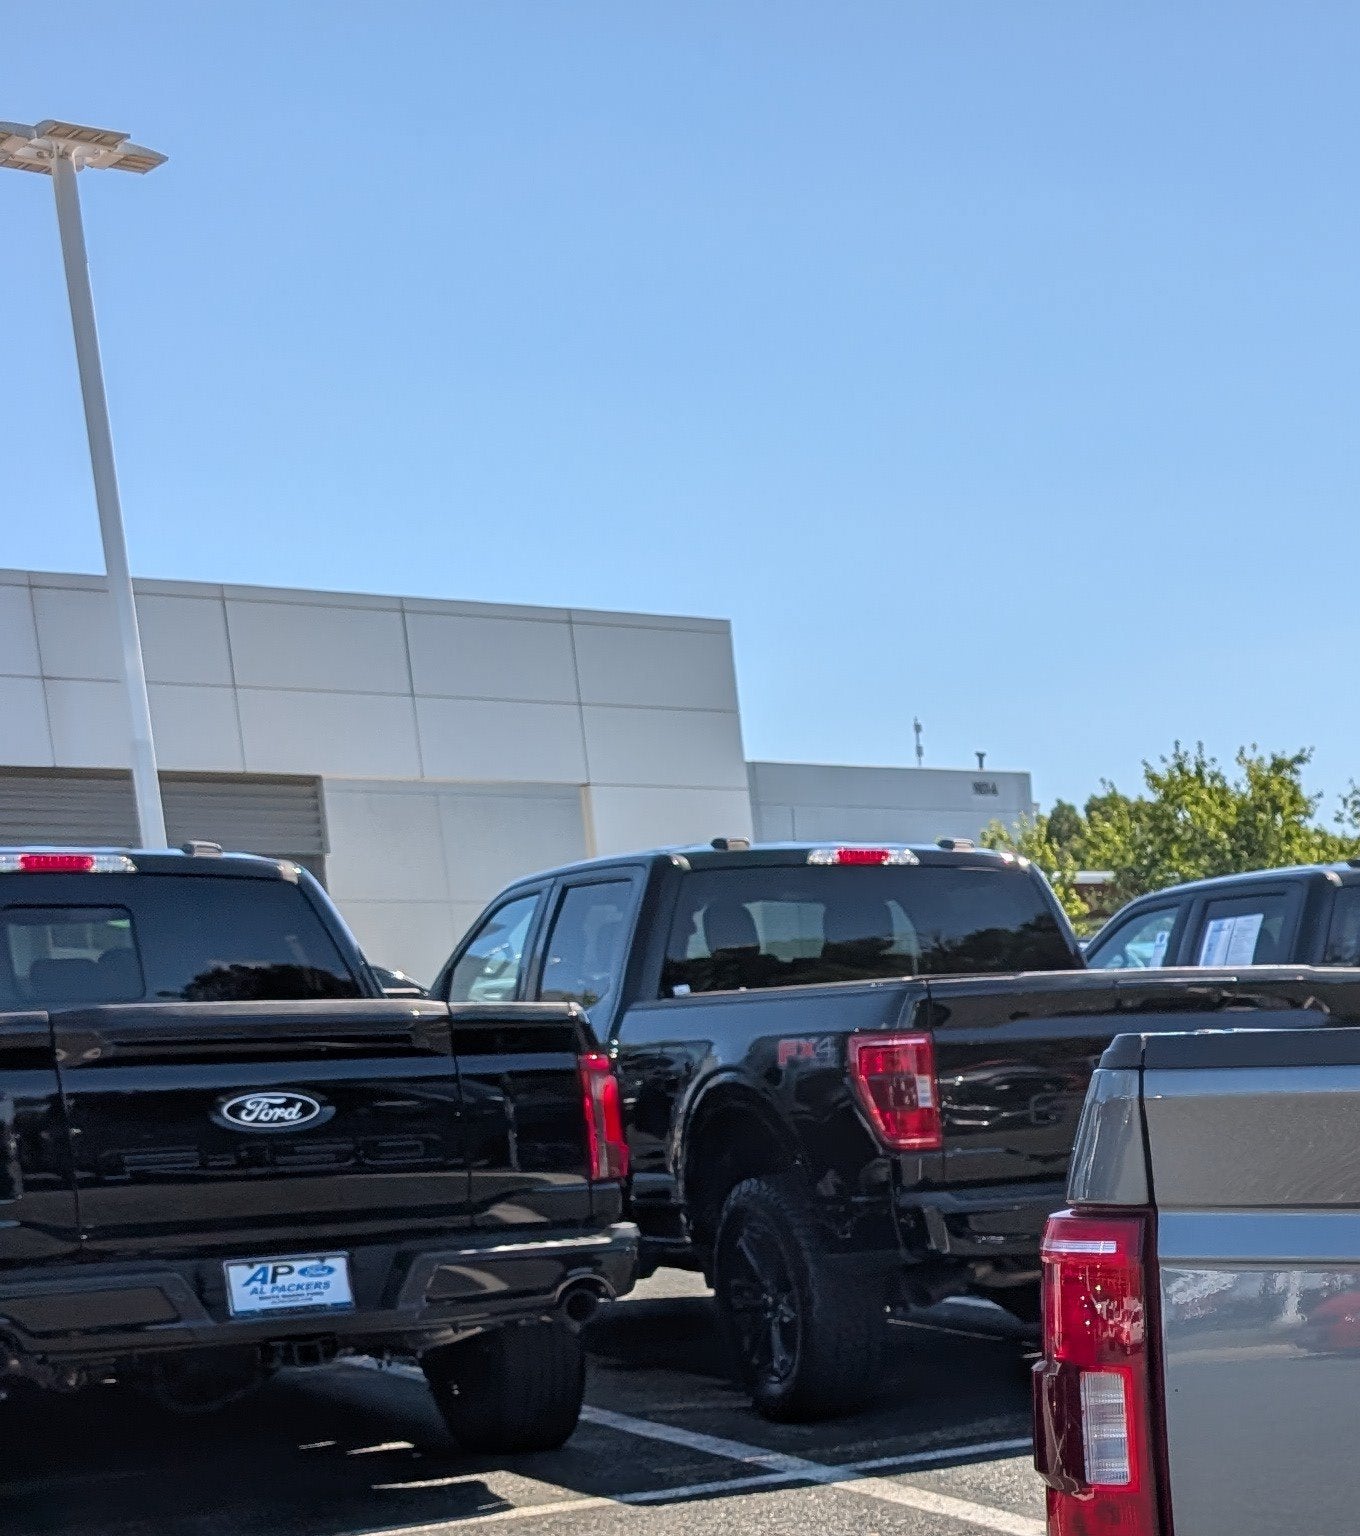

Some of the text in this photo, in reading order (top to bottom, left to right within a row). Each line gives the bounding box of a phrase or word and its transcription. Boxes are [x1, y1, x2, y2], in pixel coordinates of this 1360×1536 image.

[778, 1036, 837, 1068] FX4
[239, 1097, 303, 1122] Ford
[242, 1264, 295, 1287] AP
